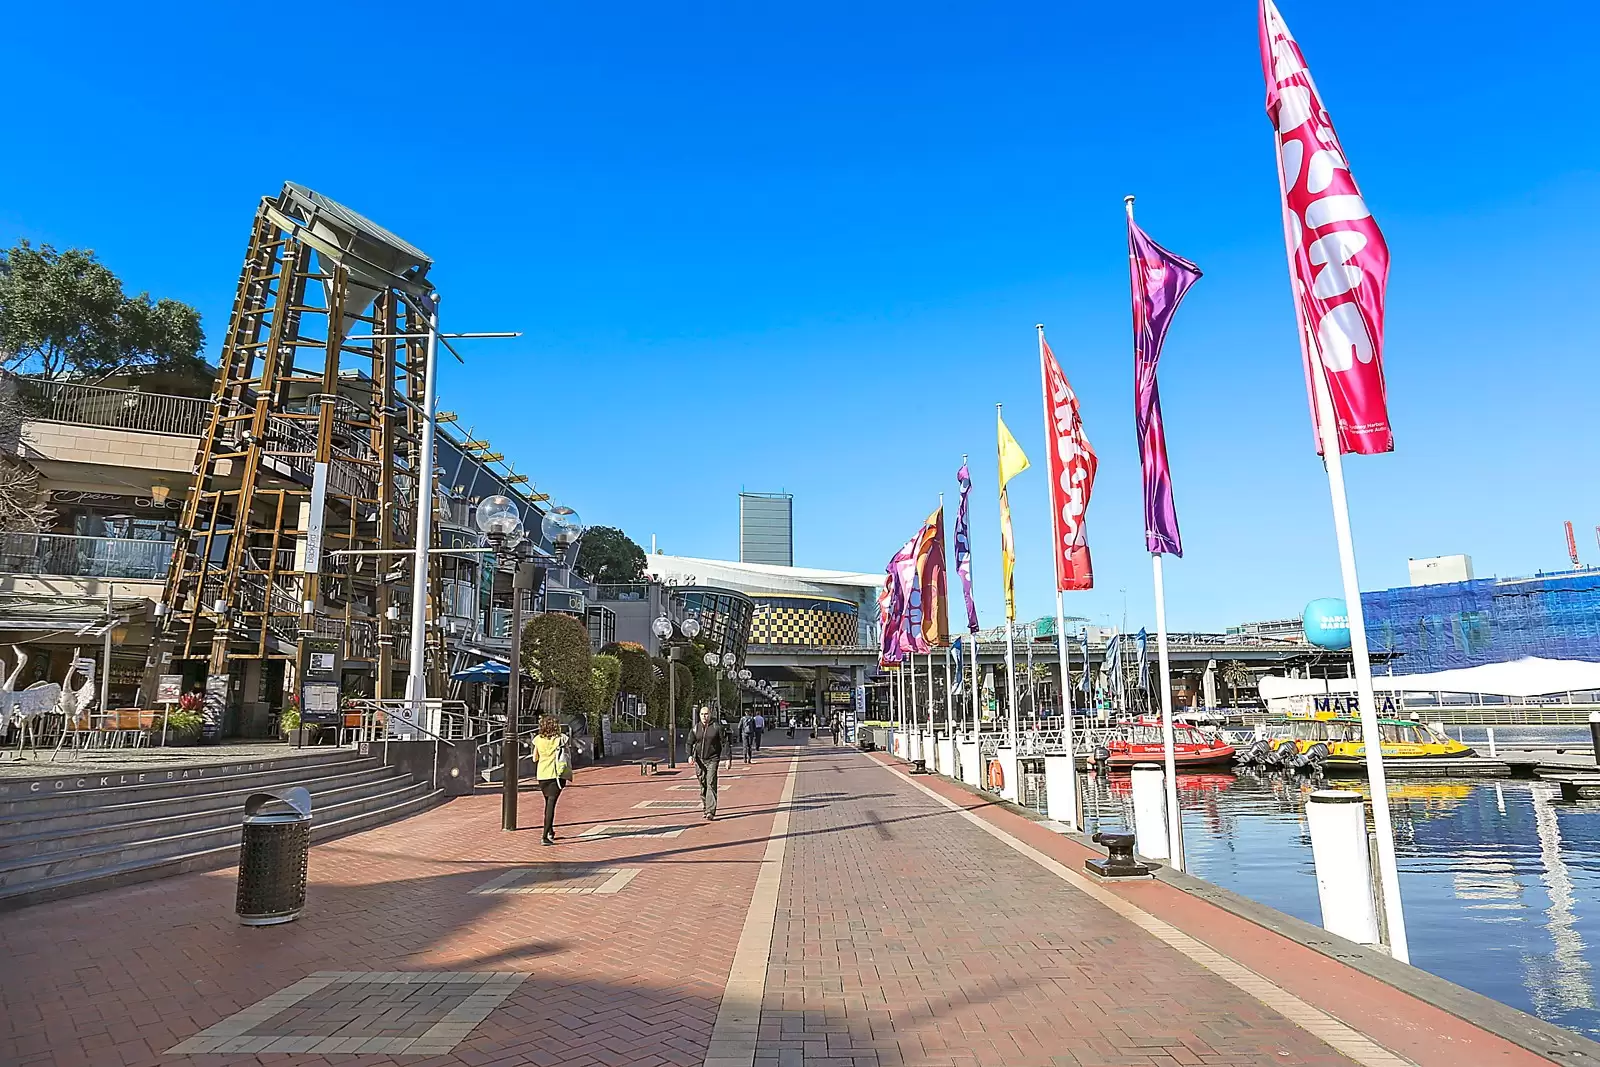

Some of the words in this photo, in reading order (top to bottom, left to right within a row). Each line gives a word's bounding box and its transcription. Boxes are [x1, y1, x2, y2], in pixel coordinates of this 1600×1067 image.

[54, 490, 121, 504] Open
[1313, 696, 1397, 714] MARA
[30, 773, 146, 792] COCKLE
[166, 767, 206, 780] BAY
[221, 761, 276, 774] WHARF
